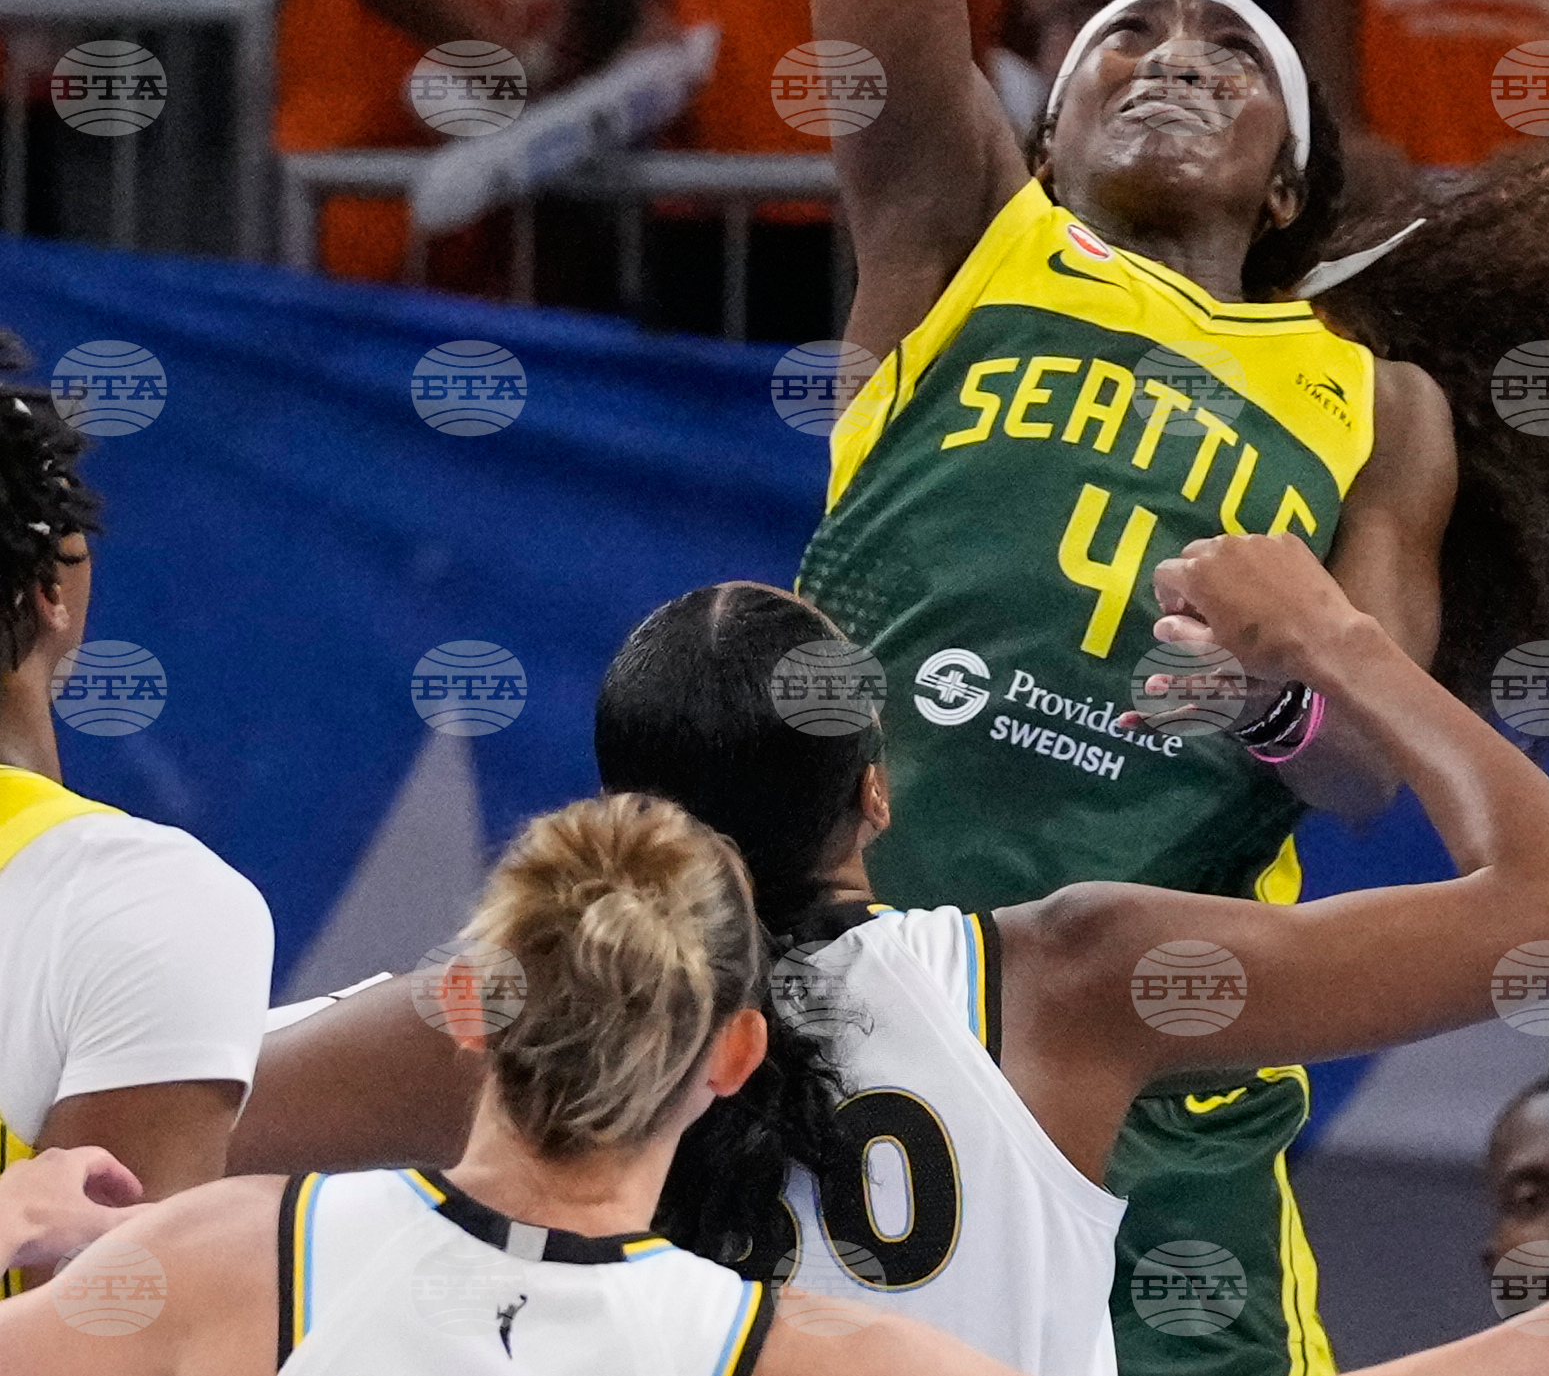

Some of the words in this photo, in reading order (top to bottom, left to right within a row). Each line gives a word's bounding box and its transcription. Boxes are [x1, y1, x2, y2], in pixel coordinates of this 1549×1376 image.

[1295, 373, 1351, 432] SYMETRA
[1059, 483, 1158, 659] 4
[990, 715, 1125, 781] SWEDISH
